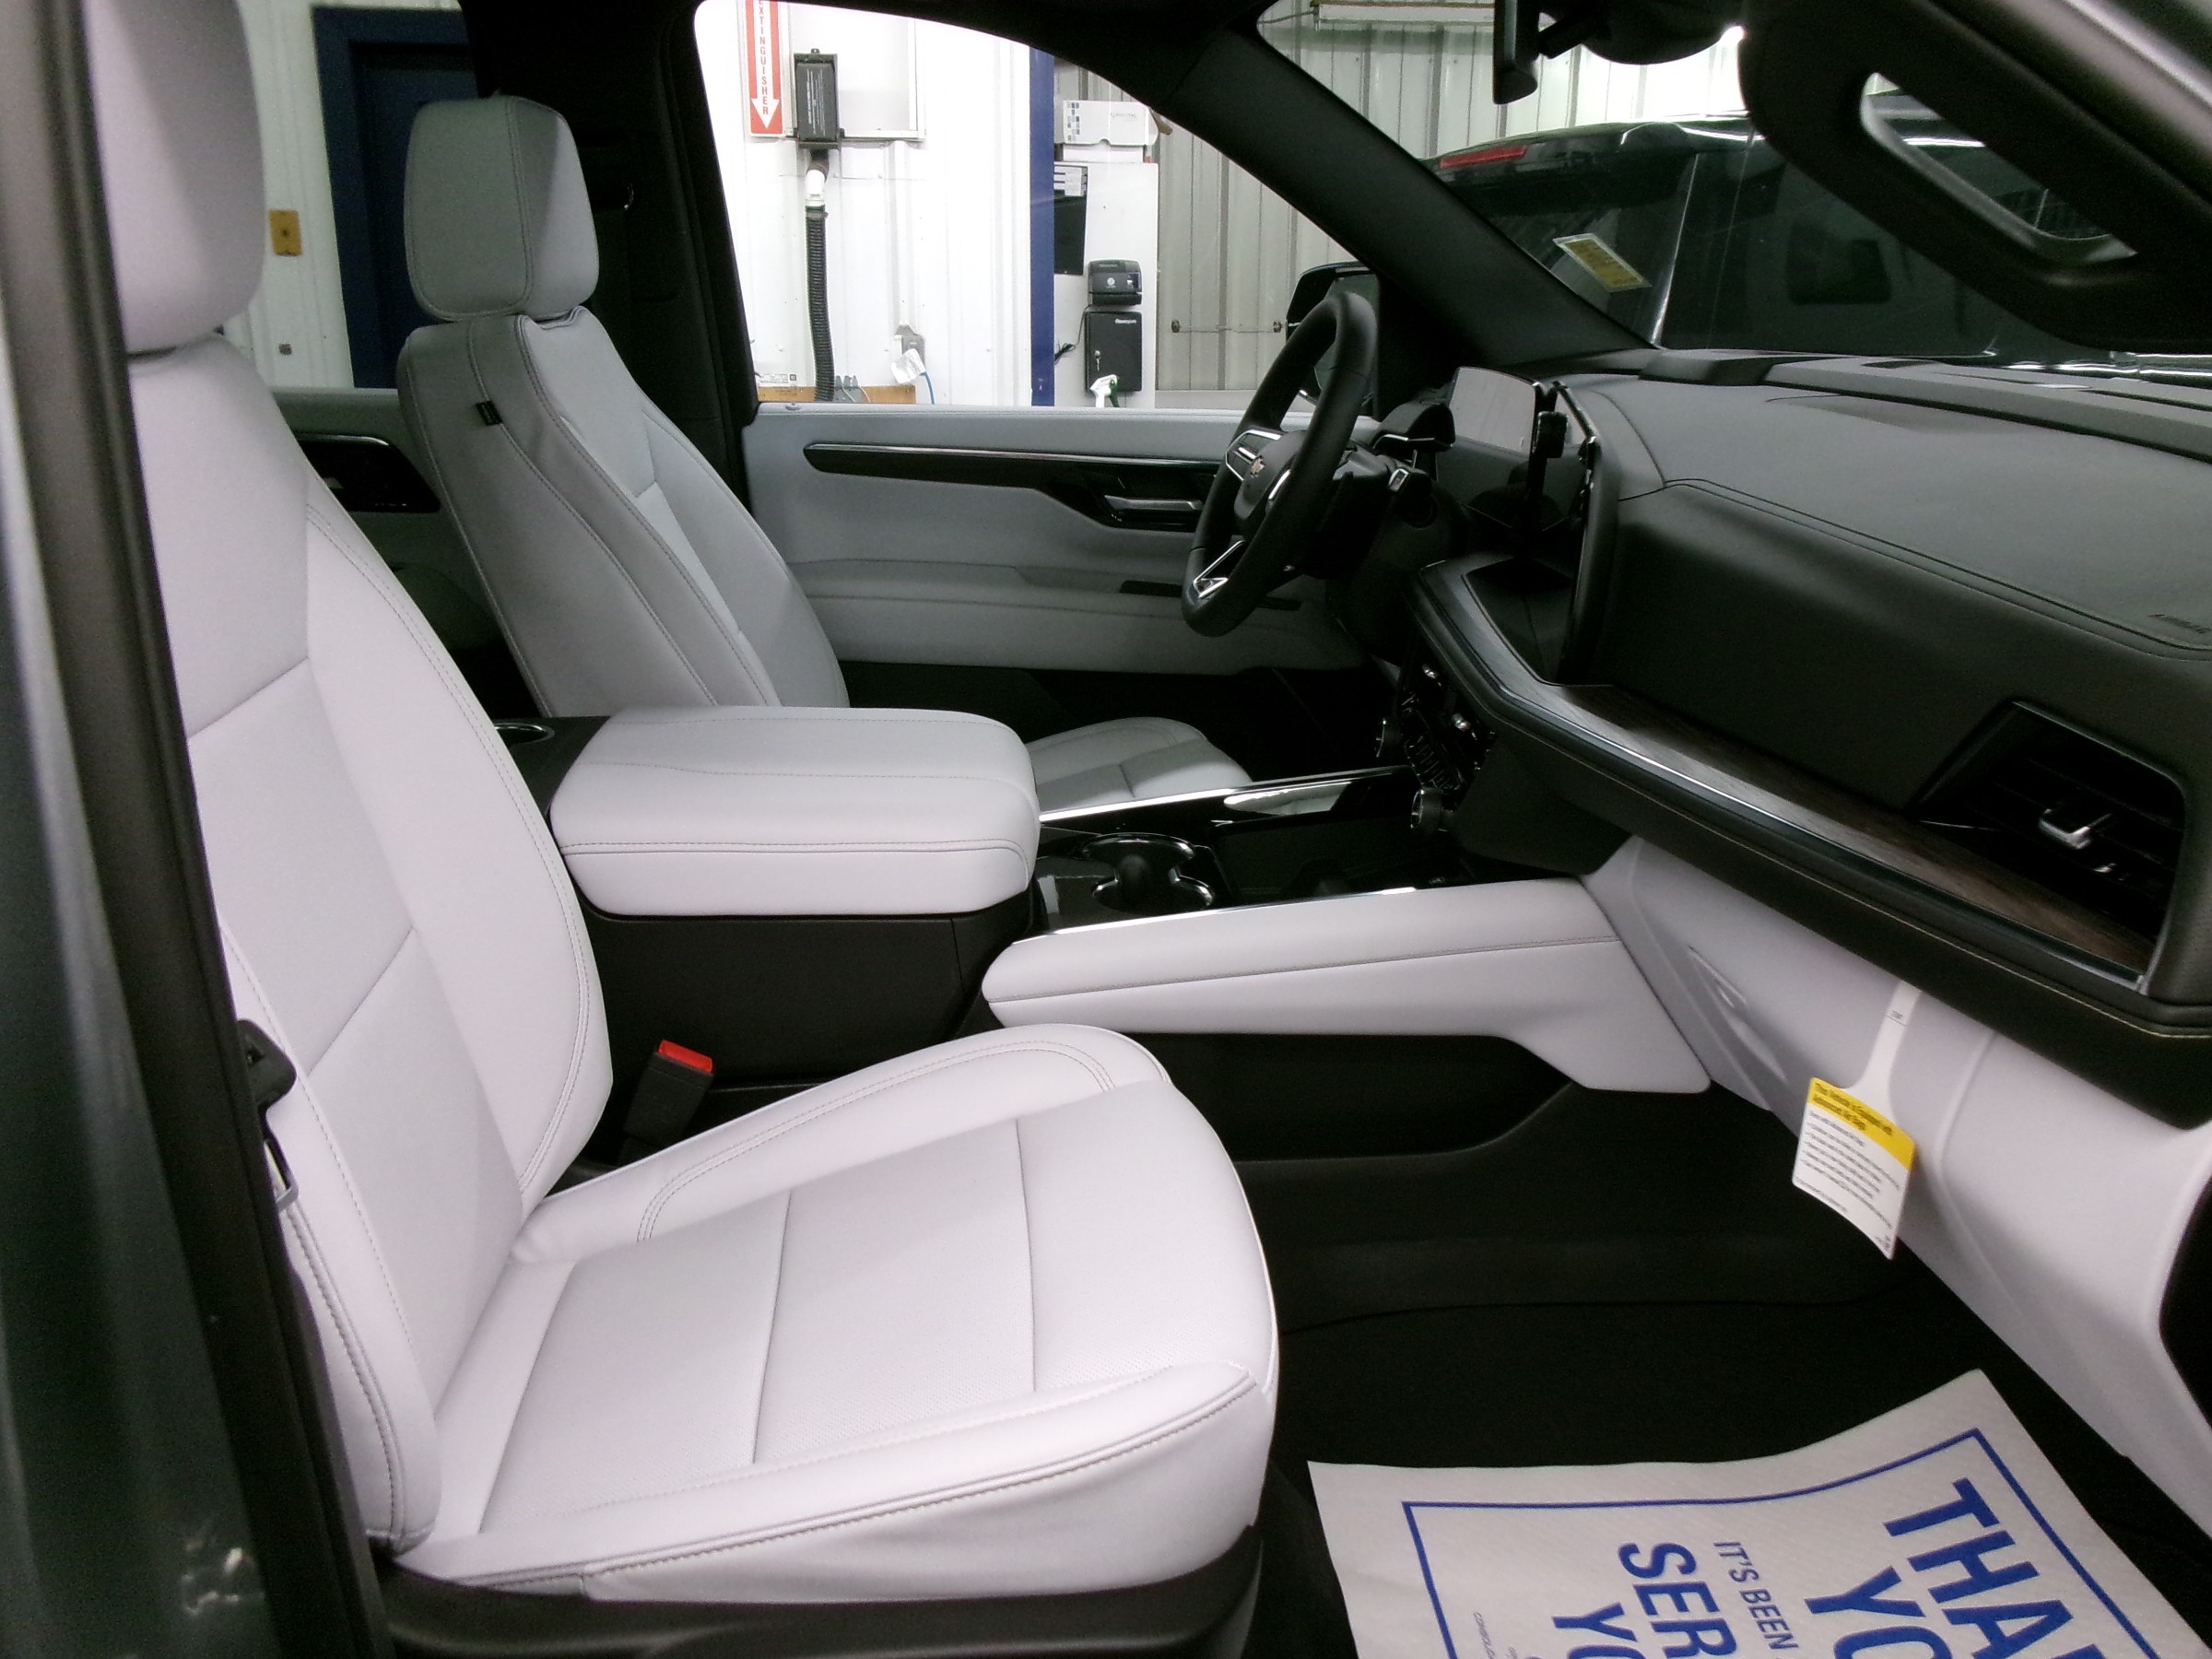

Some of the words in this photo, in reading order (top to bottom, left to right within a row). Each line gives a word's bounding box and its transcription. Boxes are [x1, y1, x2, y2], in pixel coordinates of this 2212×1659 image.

[1618, 1542, 1737, 1659] SER
[1713, 1541, 1759, 1583] IT'S
[1739, 1589, 1799, 1650] BEEN
[1883, 1477, 2109, 1659] THA
